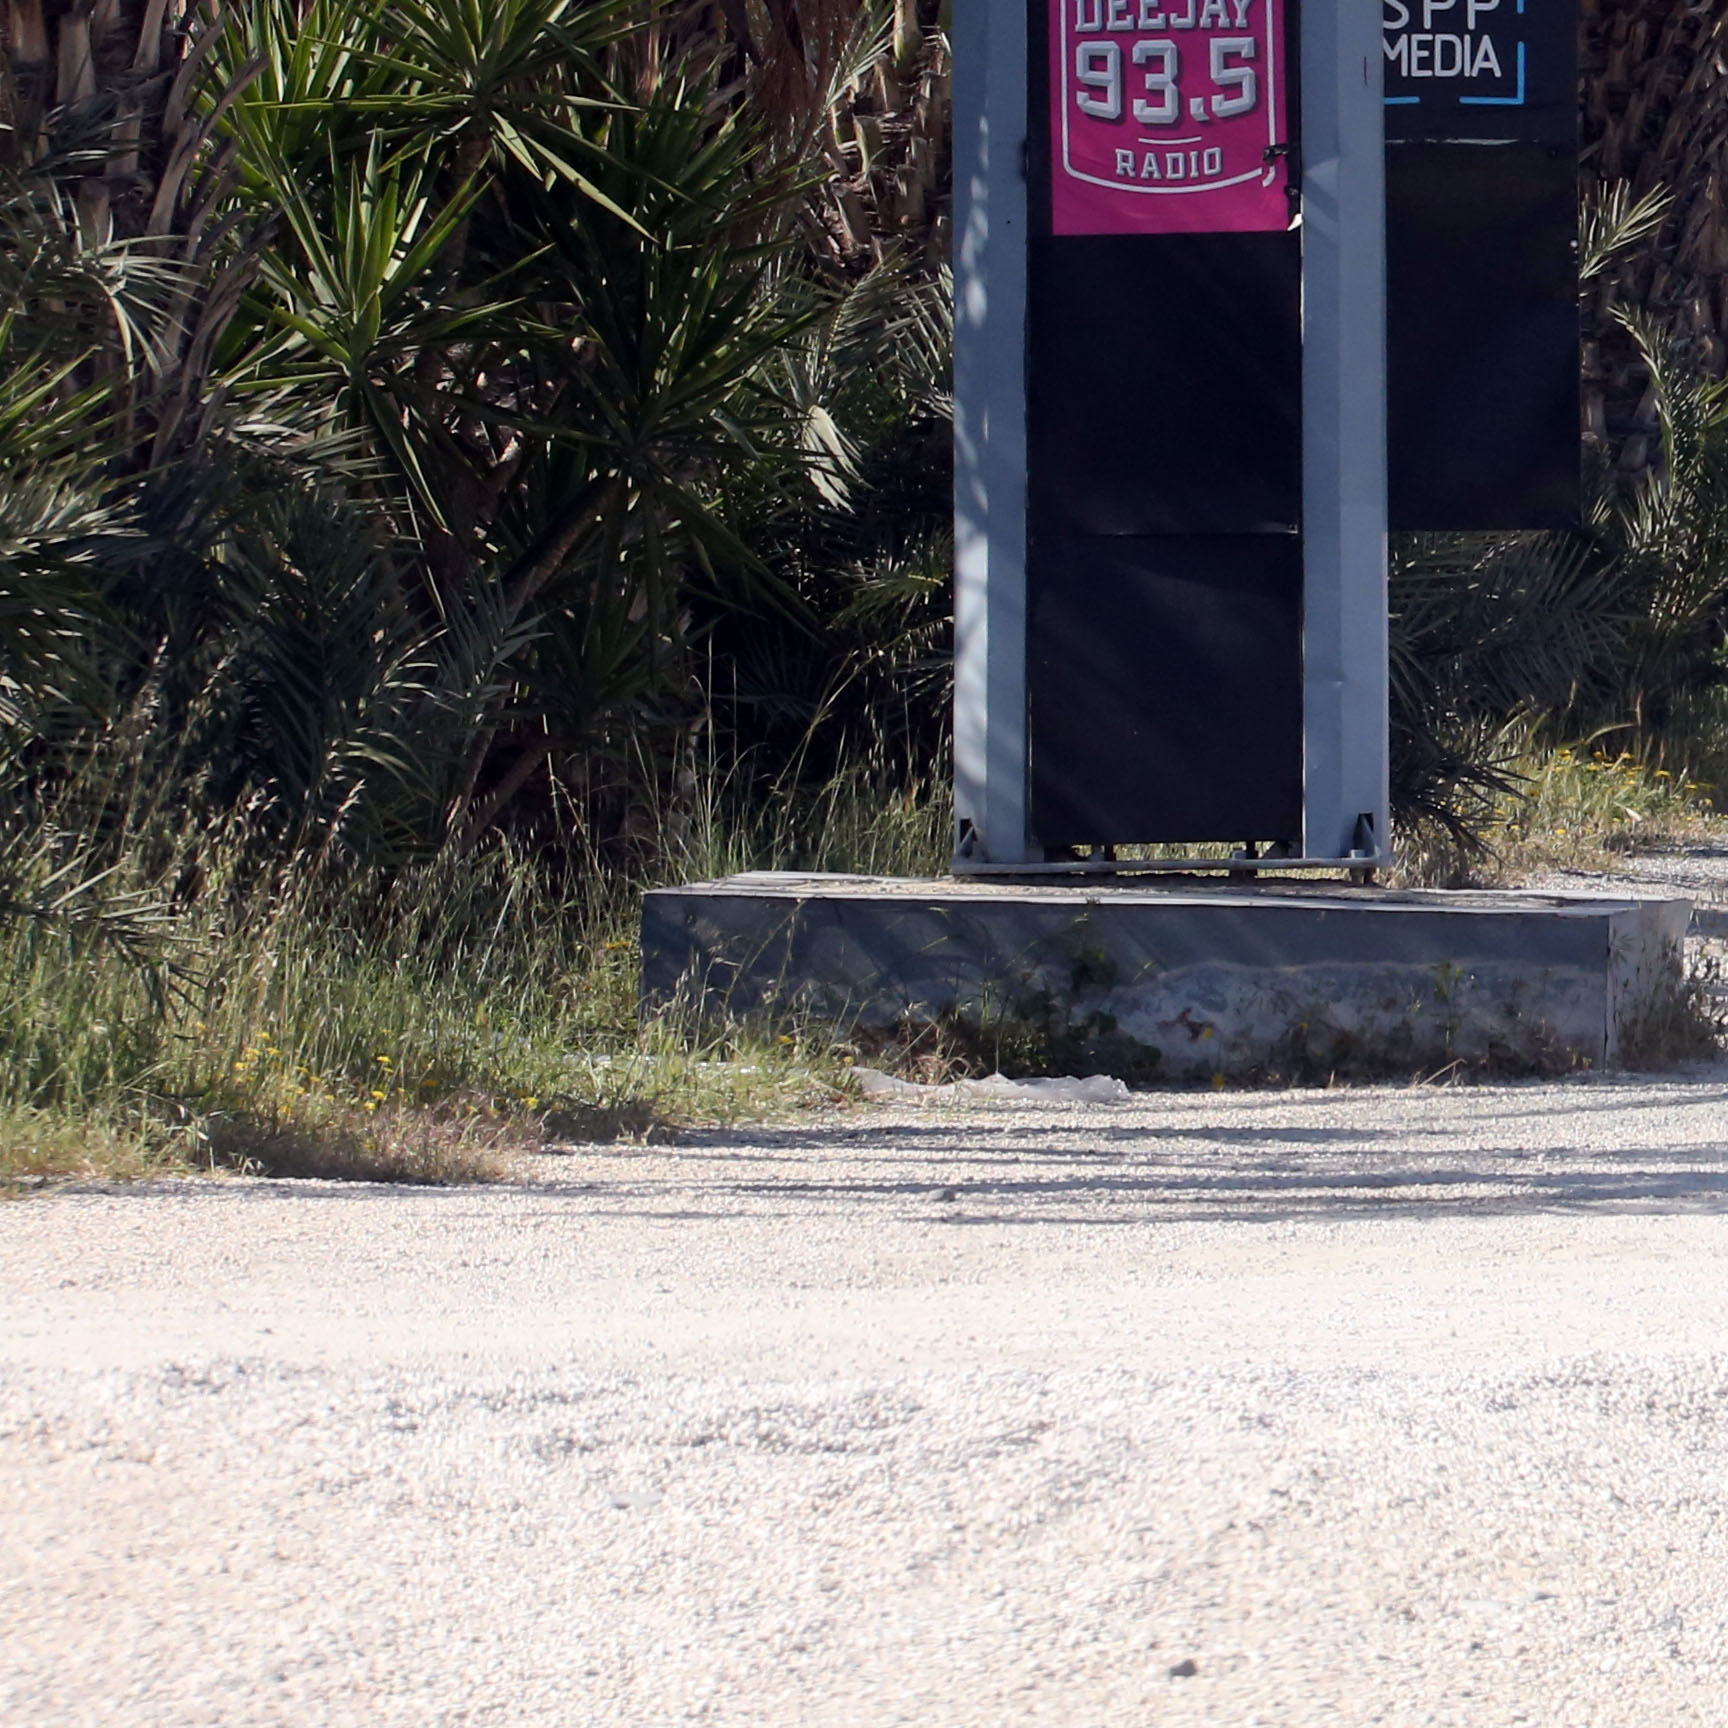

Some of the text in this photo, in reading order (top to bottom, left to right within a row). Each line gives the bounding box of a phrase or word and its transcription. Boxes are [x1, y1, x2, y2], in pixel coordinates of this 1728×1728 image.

[1382, 33, 1502, 79] MEDIA
[1074, 35, 1258, 125] 93.5
[1114, 146, 1224, 181] RADIO
